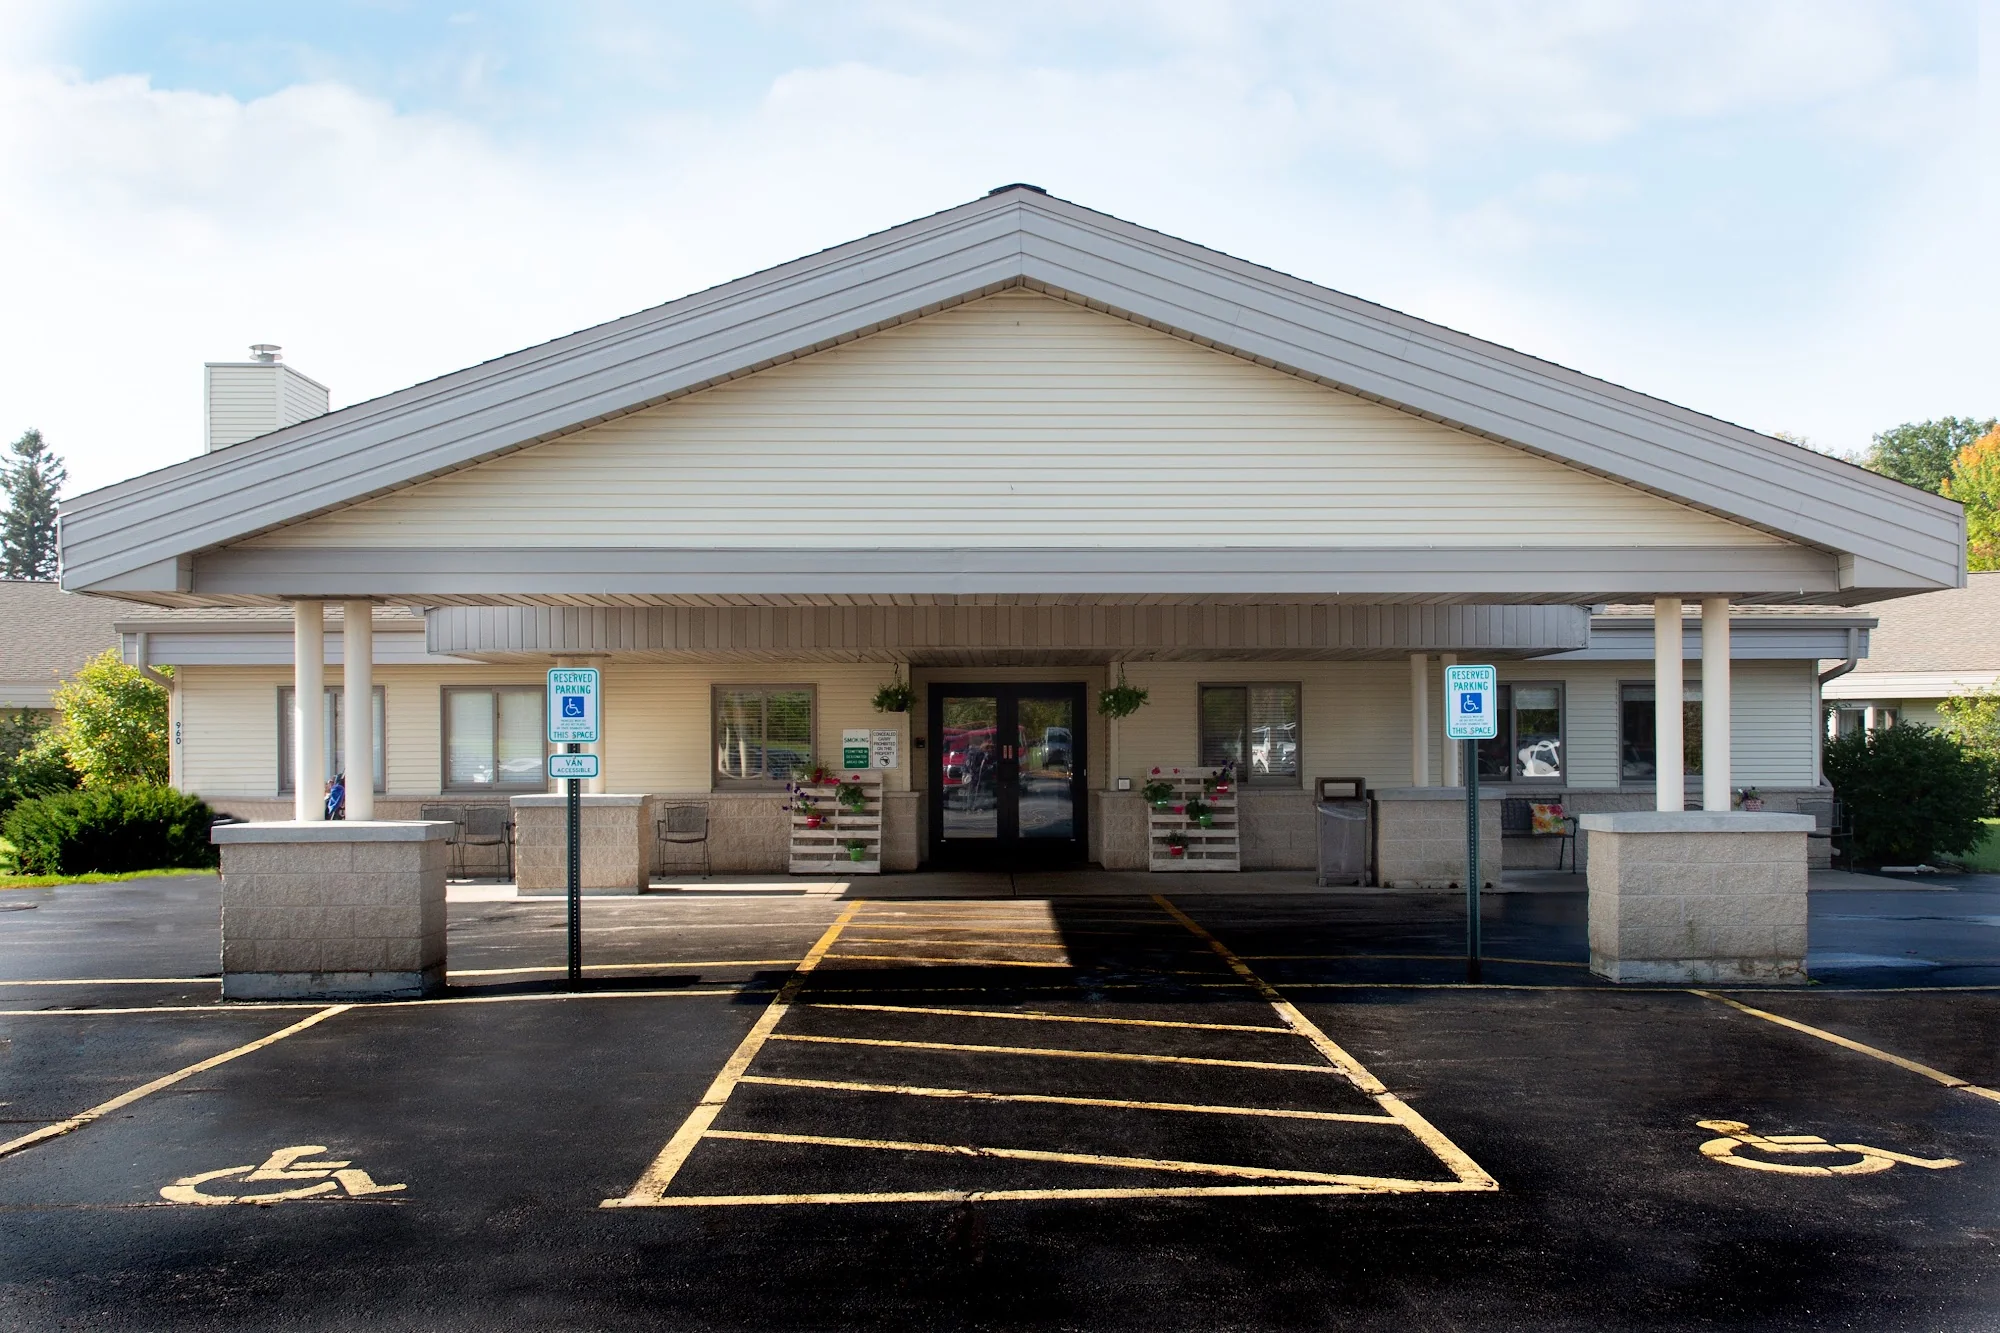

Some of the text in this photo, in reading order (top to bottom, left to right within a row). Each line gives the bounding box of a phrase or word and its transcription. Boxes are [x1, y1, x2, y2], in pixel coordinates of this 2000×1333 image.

[553, 674, 593, 683] RESERVED
[1452, 671, 1490, 680] RESERVED
[555, 685, 591, 694] PARKING
[1453, 682, 1489, 691] PARKING
[553, 731, 594, 739] THIS SPACE
[1452, 727, 1492, 735] THIS SPACE
